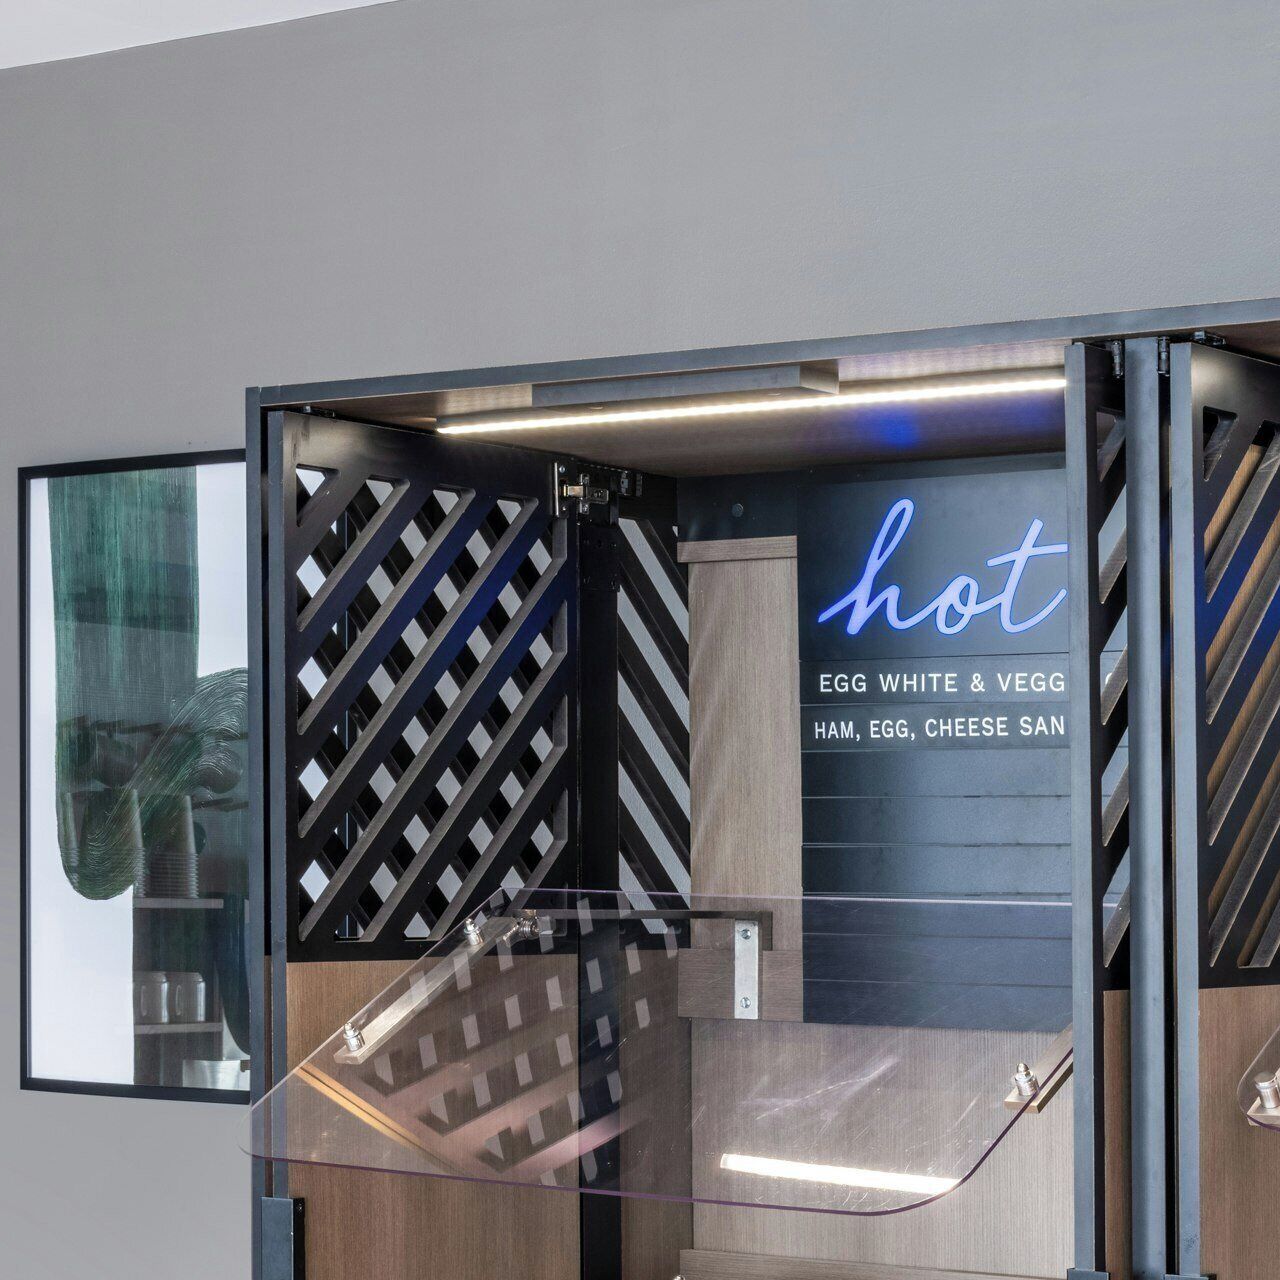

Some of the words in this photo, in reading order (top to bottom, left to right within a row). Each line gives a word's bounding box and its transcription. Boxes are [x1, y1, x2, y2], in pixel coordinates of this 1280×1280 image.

[818, 498, 1068, 635] hot
[819, 673, 867, 693] EGG
[879, 673, 958, 692] WHITE
[970, 672, 986, 693] &
[996, 672, 1065, 692] VEGG
[814, 721, 860, 742] HAM,
[870, 719, 915, 741] EGG,
[925, 716, 1009, 738] CHEESE
[1019, 715, 1065, 736] SAN
